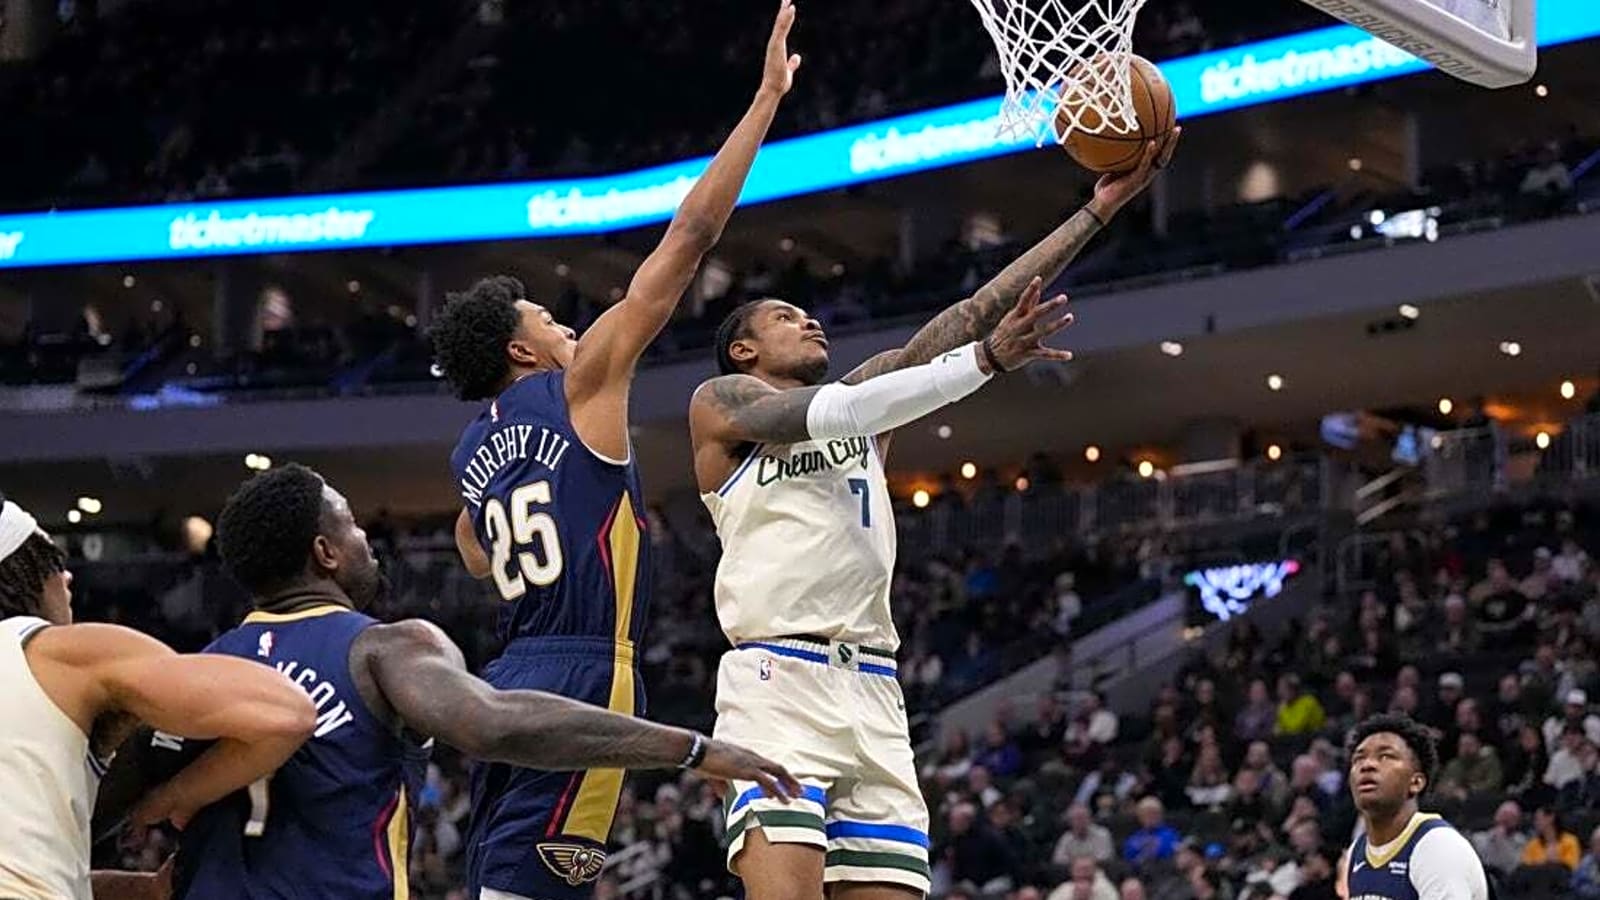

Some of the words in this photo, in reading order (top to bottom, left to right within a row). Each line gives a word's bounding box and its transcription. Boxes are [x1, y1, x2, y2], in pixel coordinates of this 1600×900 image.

[169, 207, 374, 249] ticketmaster
[461, 425, 533, 508] MURPHY
[534, 428, 570, 471] III
[847, 478, 871, 528] 7
[485, 480, 563, 600] 25
